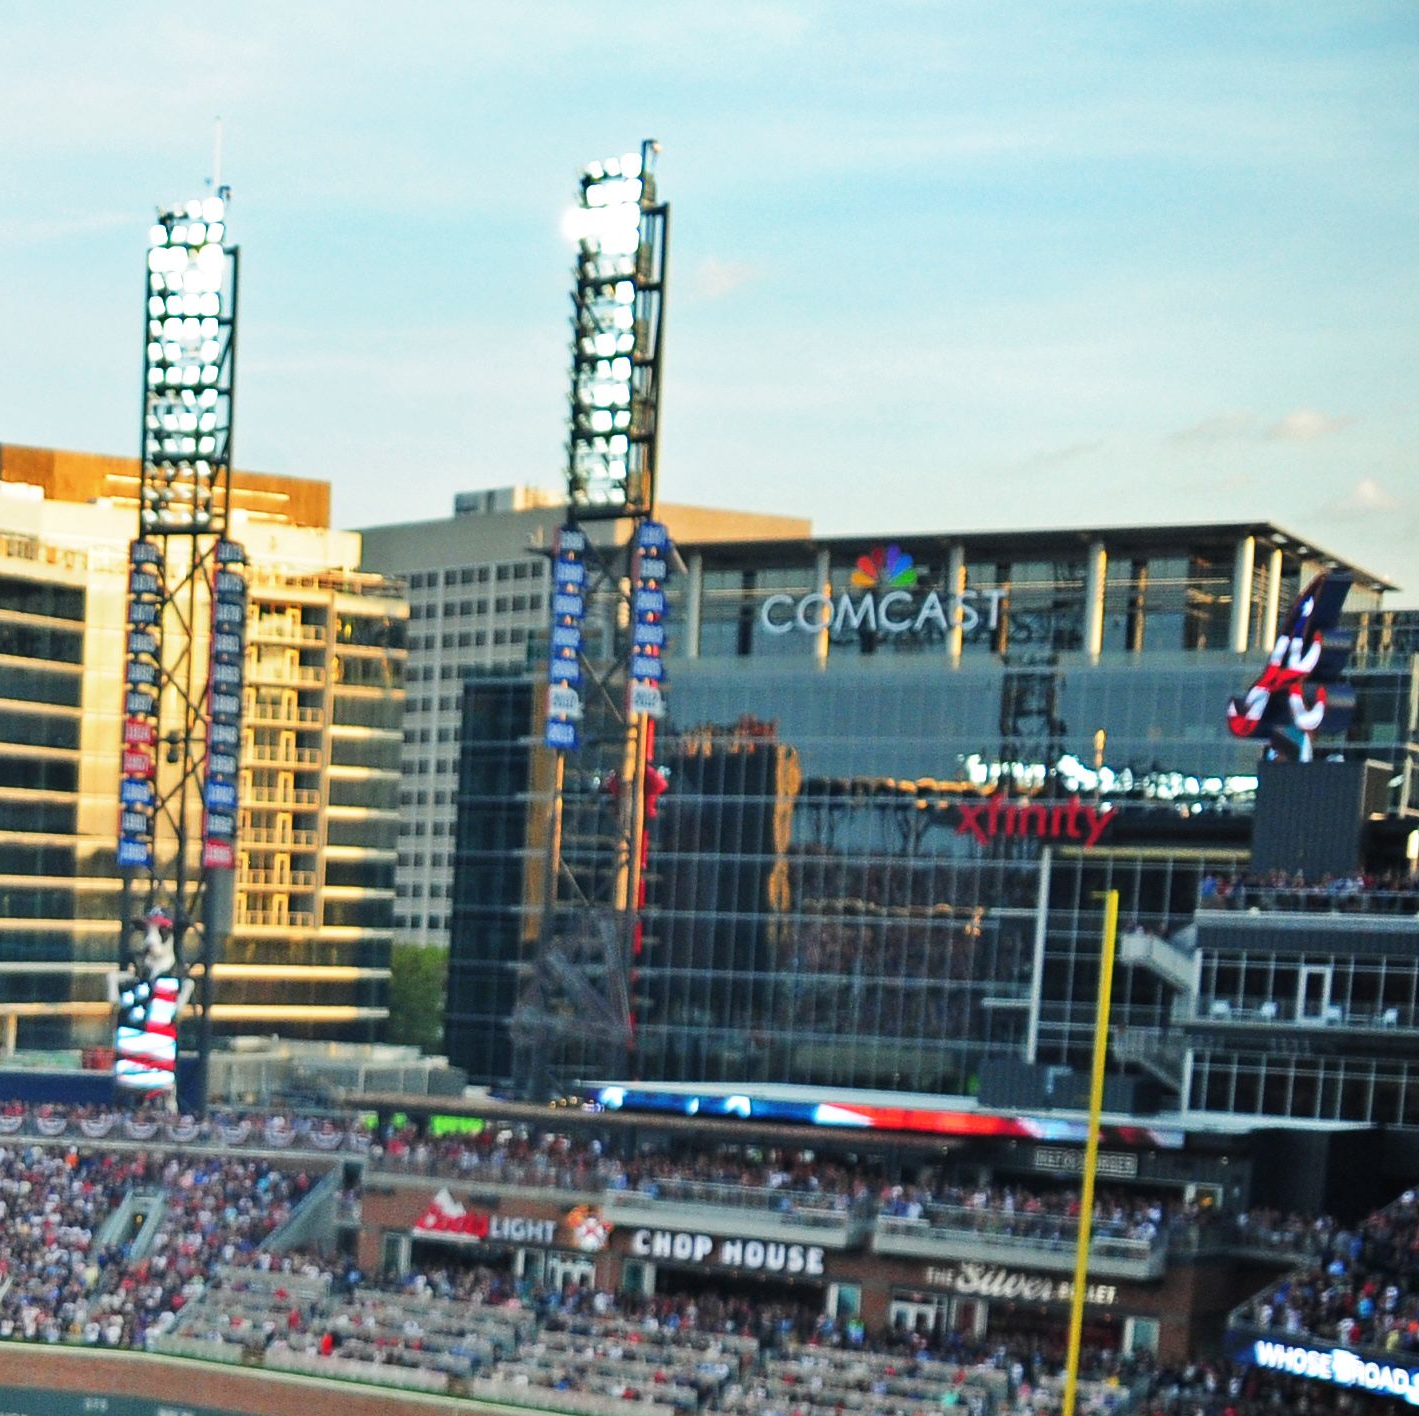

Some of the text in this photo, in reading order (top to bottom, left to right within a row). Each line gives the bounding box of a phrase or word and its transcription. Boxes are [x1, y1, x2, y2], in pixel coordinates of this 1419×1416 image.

[763, 590, 1008, 634] COMCAST
[956, 791, 1120, 851] xfinity
[489, 1216, 558, 1244] LIGHT
[632, 1228, 826, 1276] CHOP HOUSE
[1254, 1339, 1334, 1381] WHOSE
